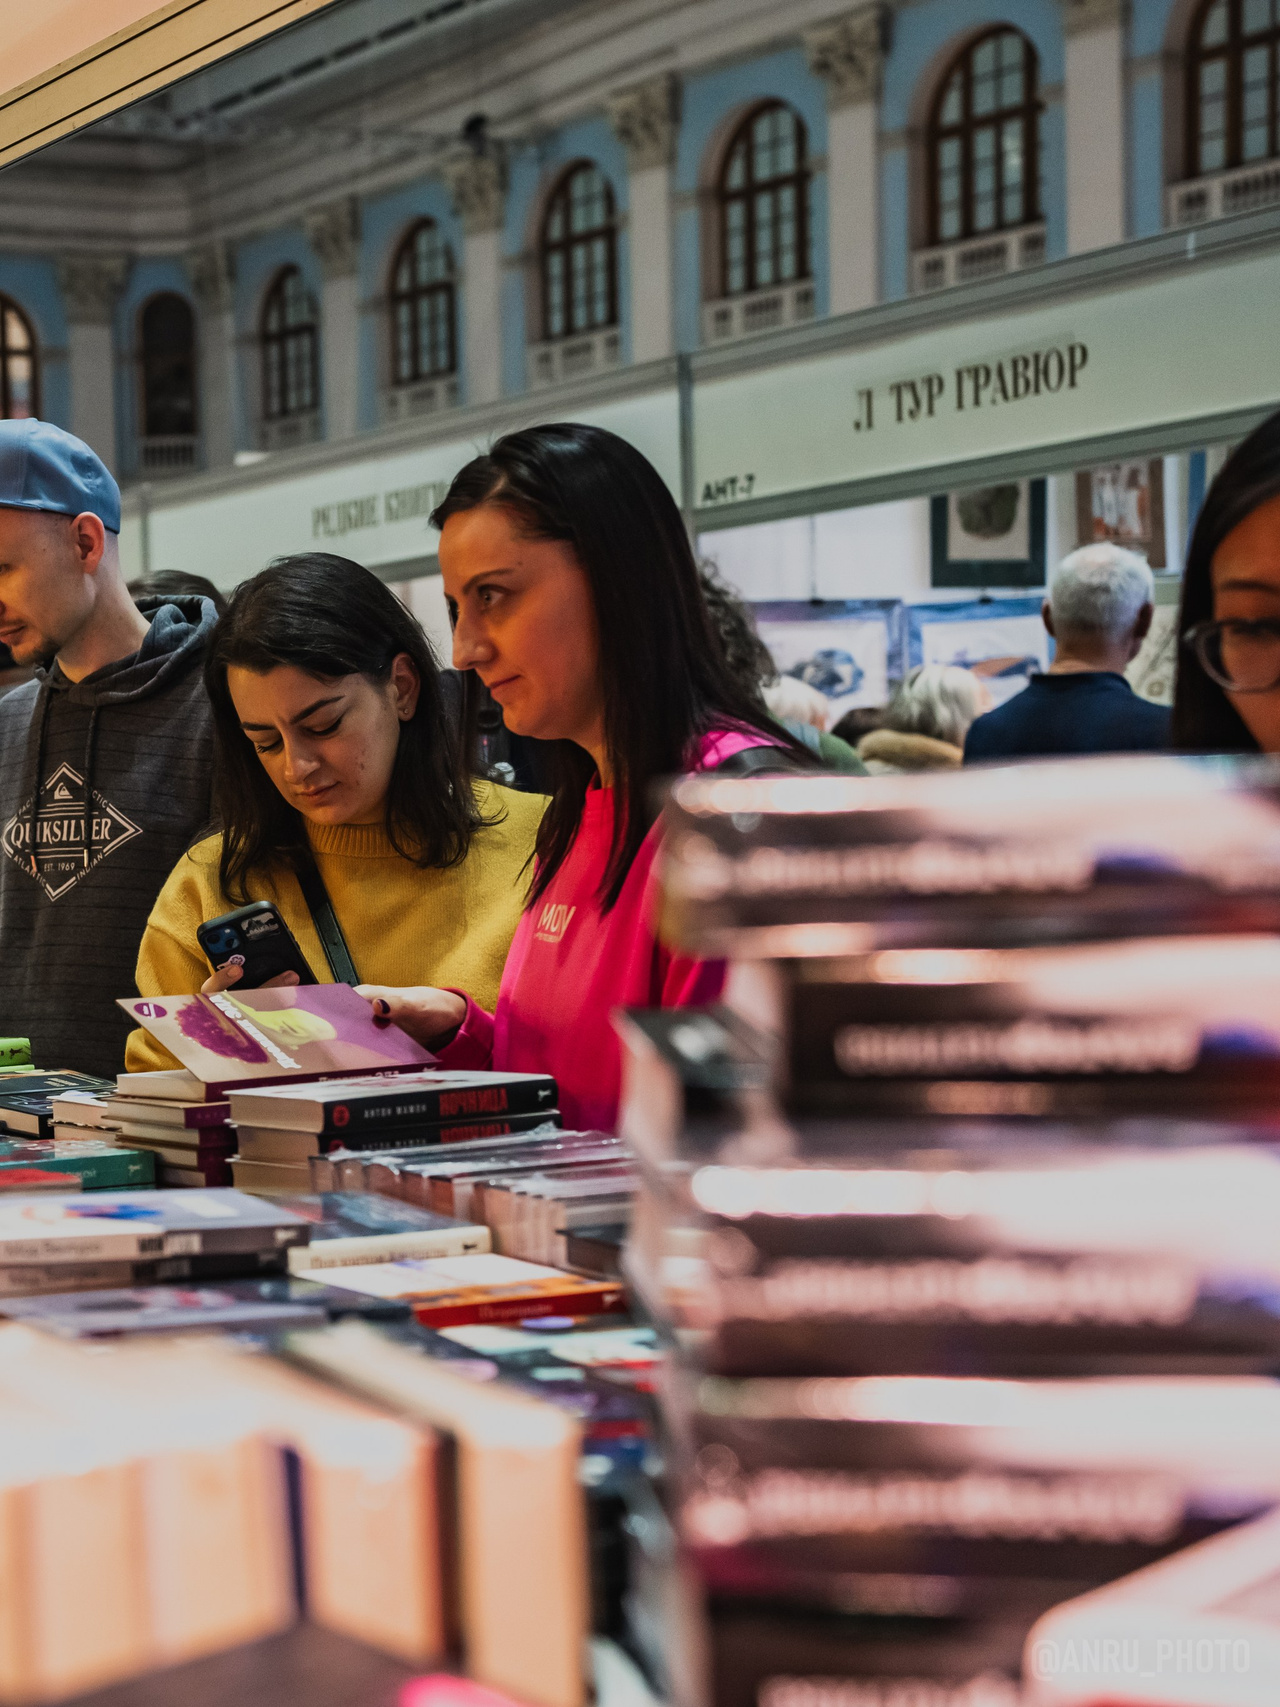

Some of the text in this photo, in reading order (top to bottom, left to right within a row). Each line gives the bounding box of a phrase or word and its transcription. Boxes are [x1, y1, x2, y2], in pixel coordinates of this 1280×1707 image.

[889, 371, 945, 424] ТУР
[954, 340, 1089, 412] ГРАВЮР
[58, 861, 76, 872] 1969
